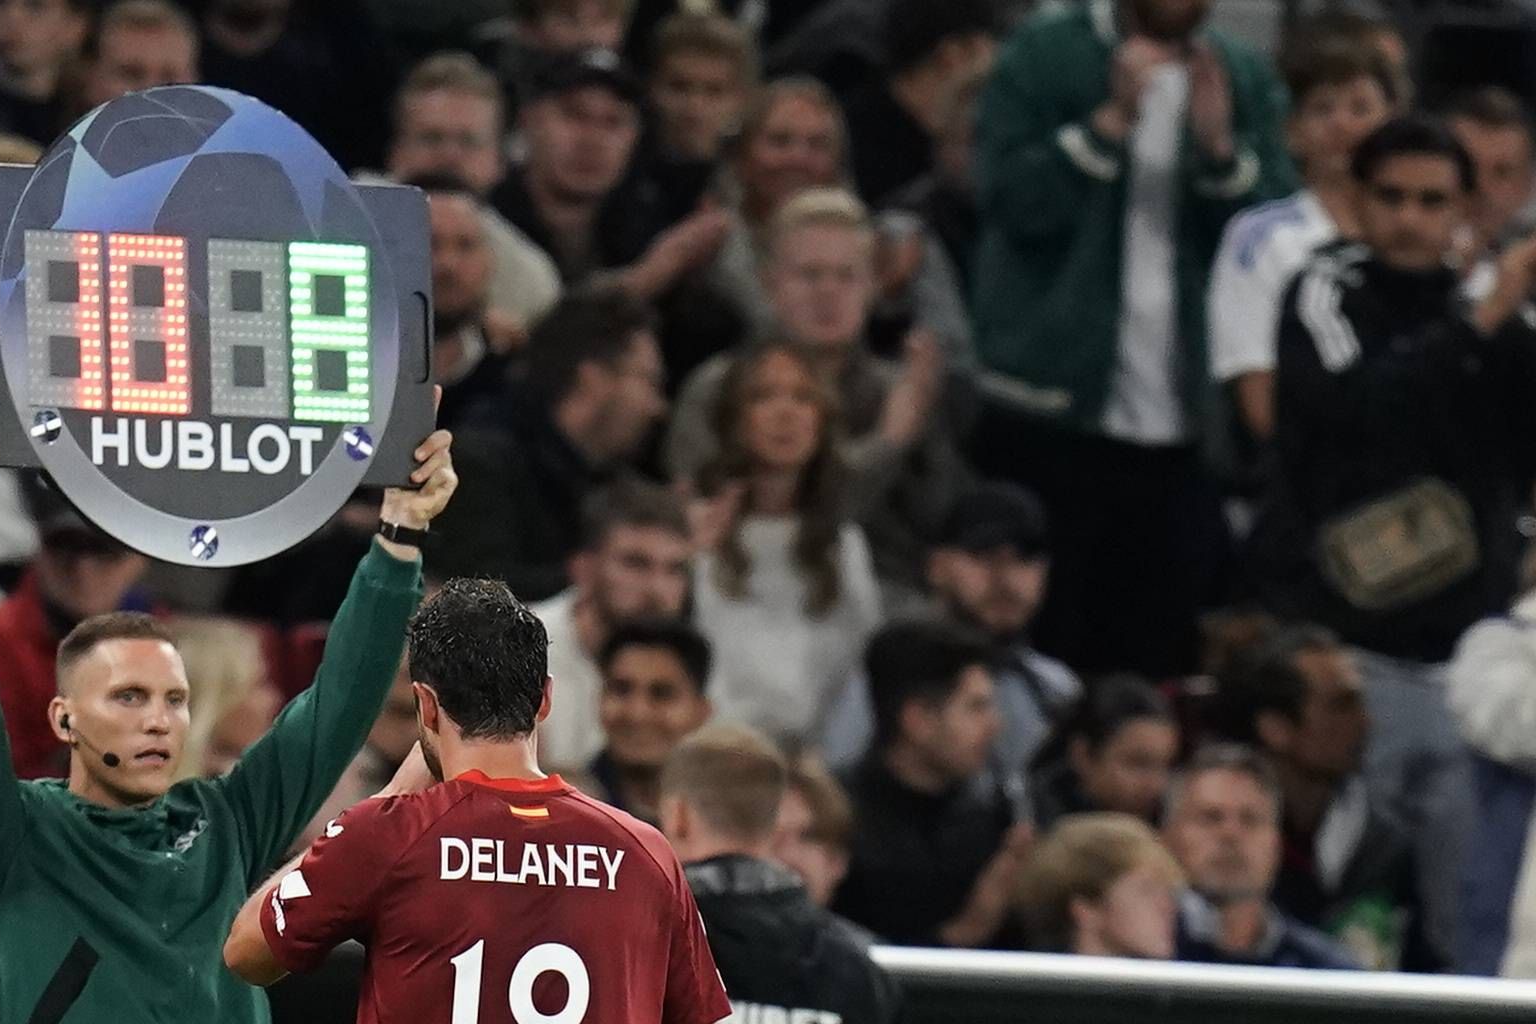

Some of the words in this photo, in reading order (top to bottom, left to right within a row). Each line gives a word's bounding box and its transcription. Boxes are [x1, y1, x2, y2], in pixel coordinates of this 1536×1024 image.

[78, 232, 192, 415] 10
[90, 416, 324, 476] HUBLOT
[439, 836, 626, 891] DELANEY
